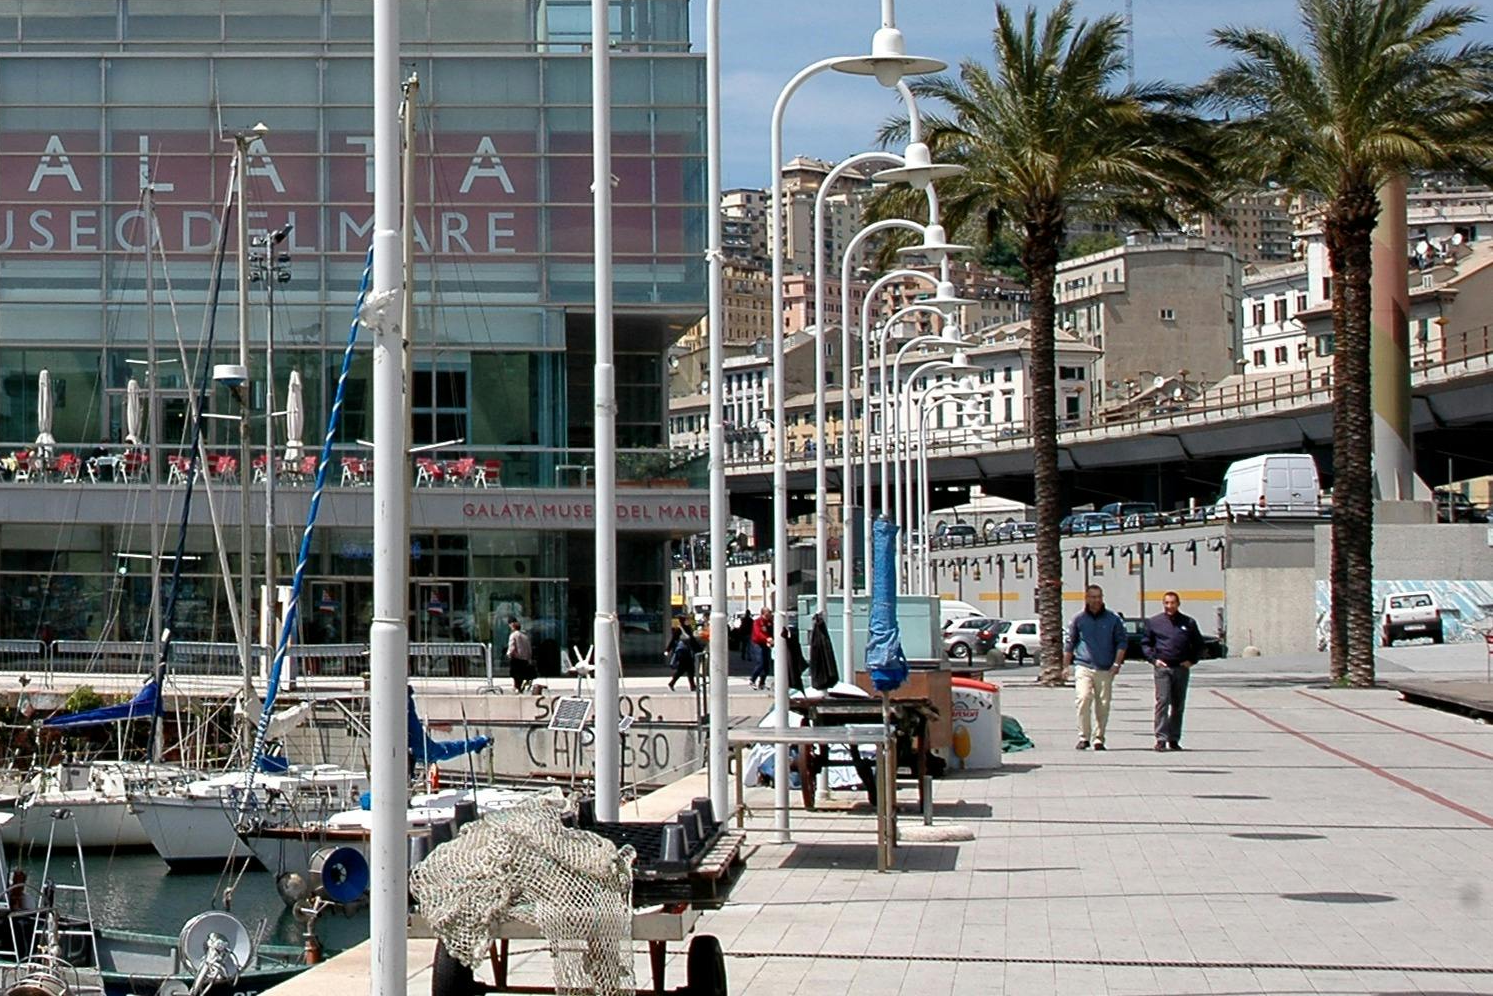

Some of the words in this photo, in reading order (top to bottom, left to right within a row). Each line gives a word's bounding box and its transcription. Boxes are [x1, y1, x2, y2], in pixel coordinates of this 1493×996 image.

[462, 502, 537, 518] GALATA
[542, 503, 595, 519] MUSE
[616, 504, 652, 519] DEL
[658, 504, 710, 519] MARE
